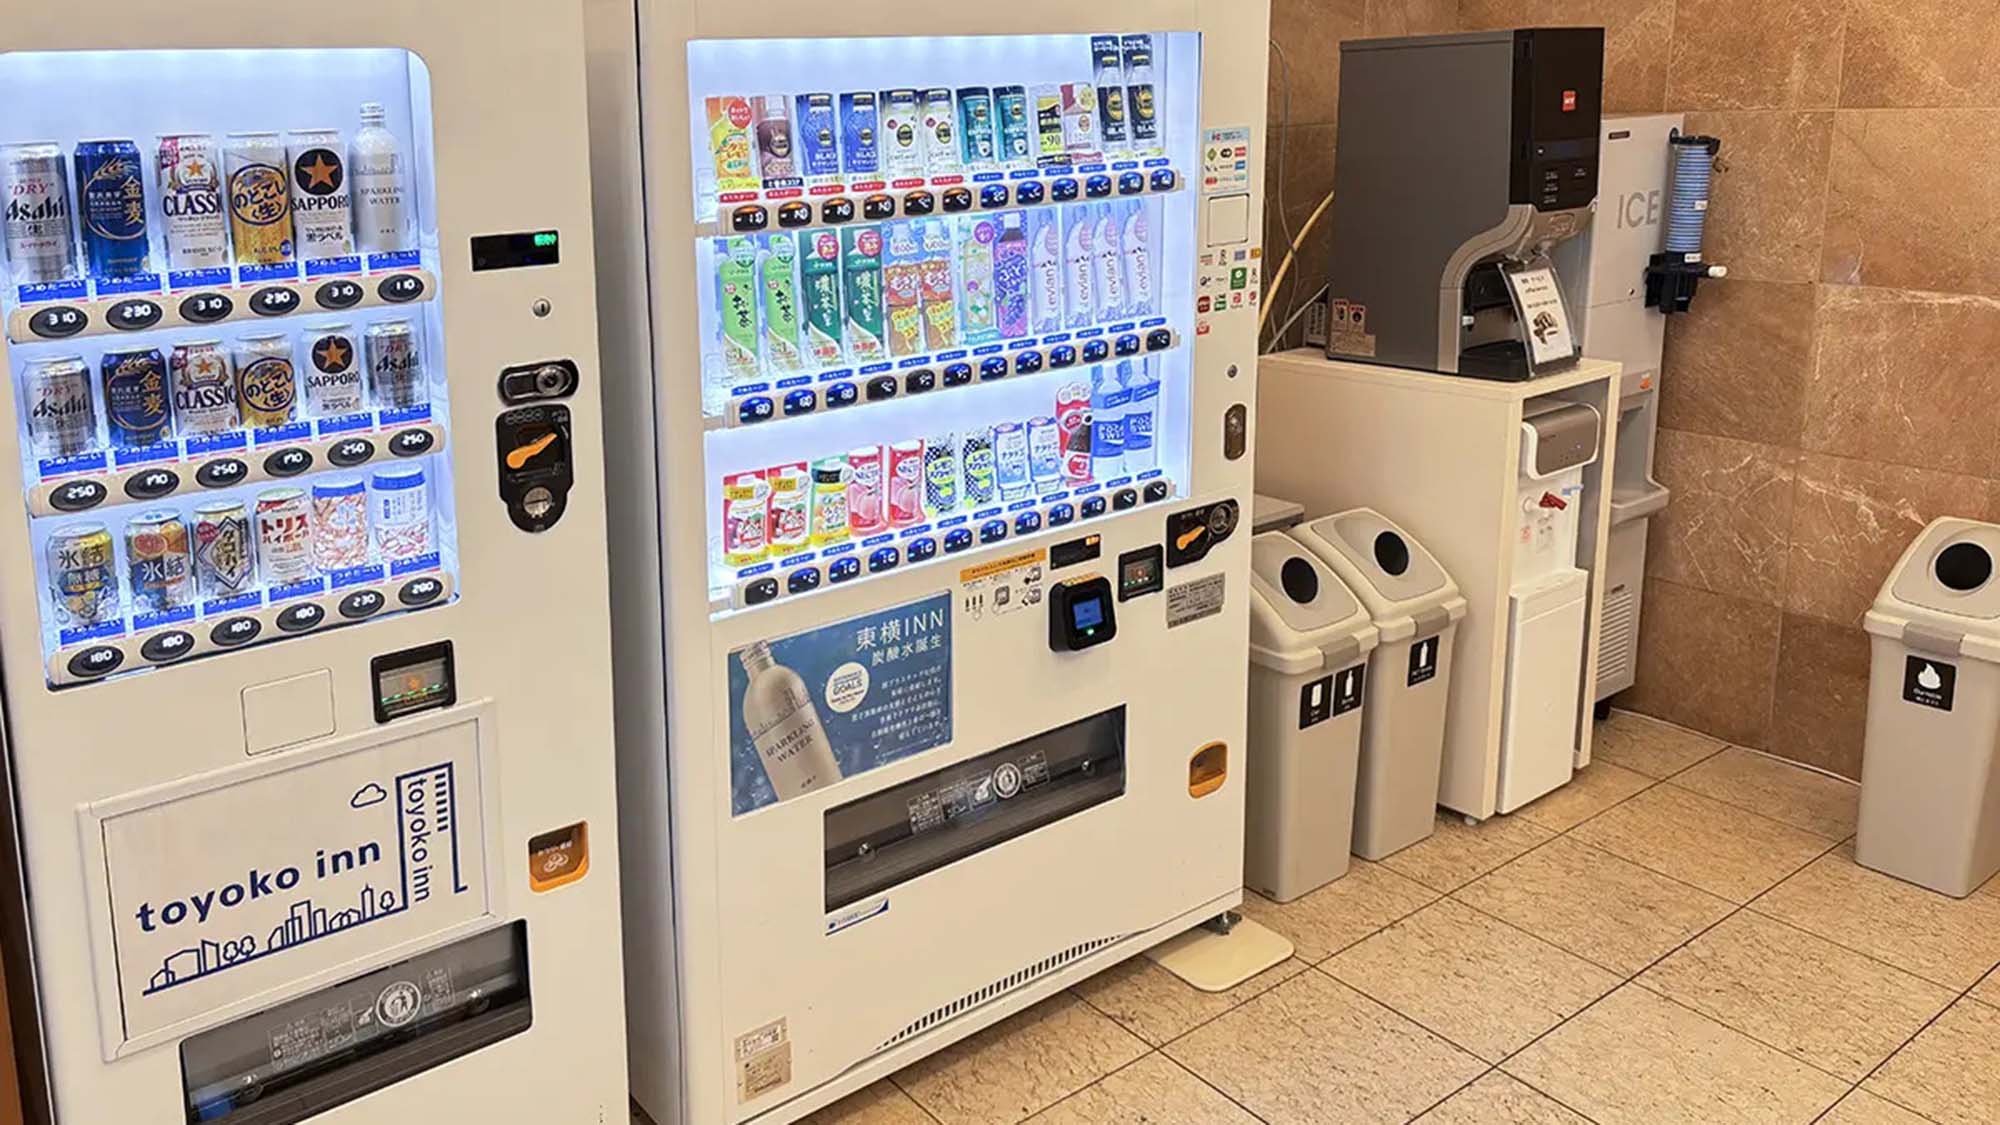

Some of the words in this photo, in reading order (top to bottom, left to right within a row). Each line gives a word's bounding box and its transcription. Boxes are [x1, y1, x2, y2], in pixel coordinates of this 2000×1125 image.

[6, 194, 65, 222] Asahi
[120, 174, 144, 226] 金麦
[1617, 189, 1661, 230] ICE
[265, 291, 290, 305] 230
[331, 285, 354, 297] 310
[122, 304, 151, 319] 230
[198, 297, 222, 311] 310
[50, 312, 77, 326] 310
[33, 393, 88, 418] Asahi
[139, 370, 164, 417] 金麦
[342, 442, 366, 455] 250
[402, 433, 425, 446] 250
[212, 463, 238, 476] 250
[67, 484, 95, 500] 250
[261, 512, 309, 534] トリス
[141, 555, 185, 582] 氷結
[353, 594, 376, 607] 230
[855, 608, 945, 653] 東横INN
[871, 633, 943, 667] 炭酸水誕生
[776, 734, 814, 764] WATER
[405, 776, 431, 865] toyoko
[135, 863, 301, 933] toyoko
[315, 840, 381, 879] inn
[412, 864, 434, 903] inn
